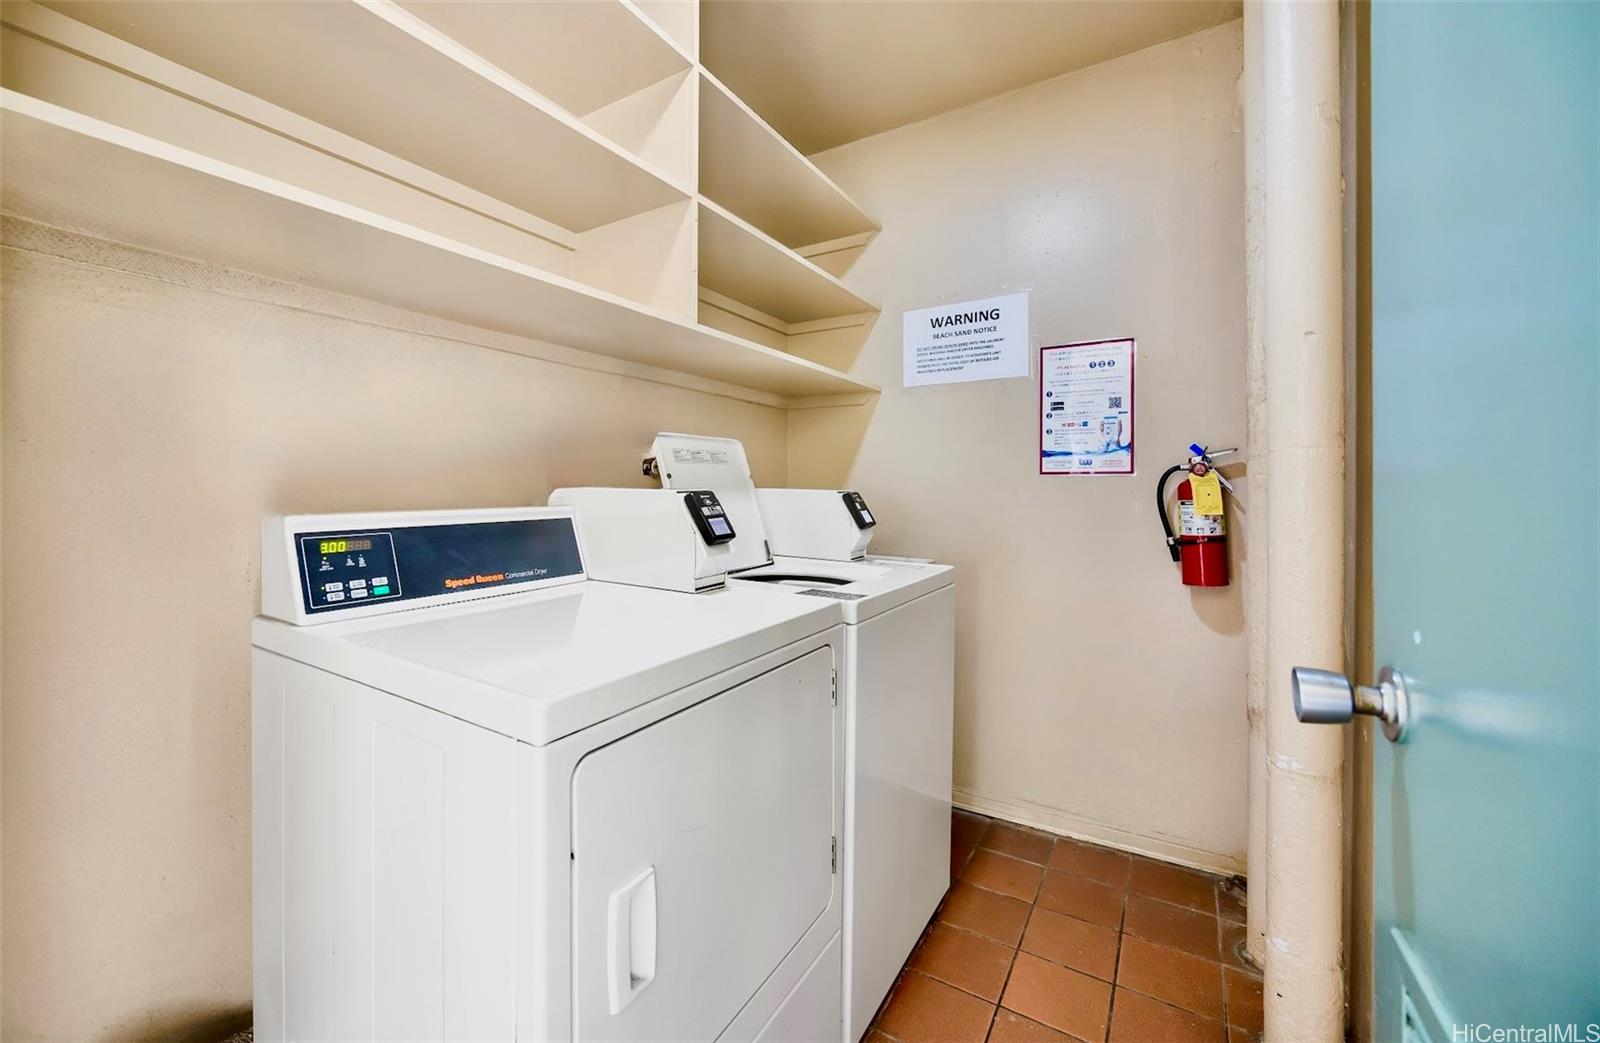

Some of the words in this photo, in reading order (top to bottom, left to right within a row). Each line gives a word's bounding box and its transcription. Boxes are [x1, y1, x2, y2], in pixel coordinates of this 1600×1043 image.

[930, 308, 1000, 328] WARNING
[933, 330, 953, 340] BEACH
[954, 328, 972, 337] SAND
[973, 325, 997, 334] NOTICE
[444, 575, 476, 588] Speed
[476, 573, 504, 584] Queen
[505, 570, 534, 579] Commercial
[534, 568, 548, 576] Dryer
